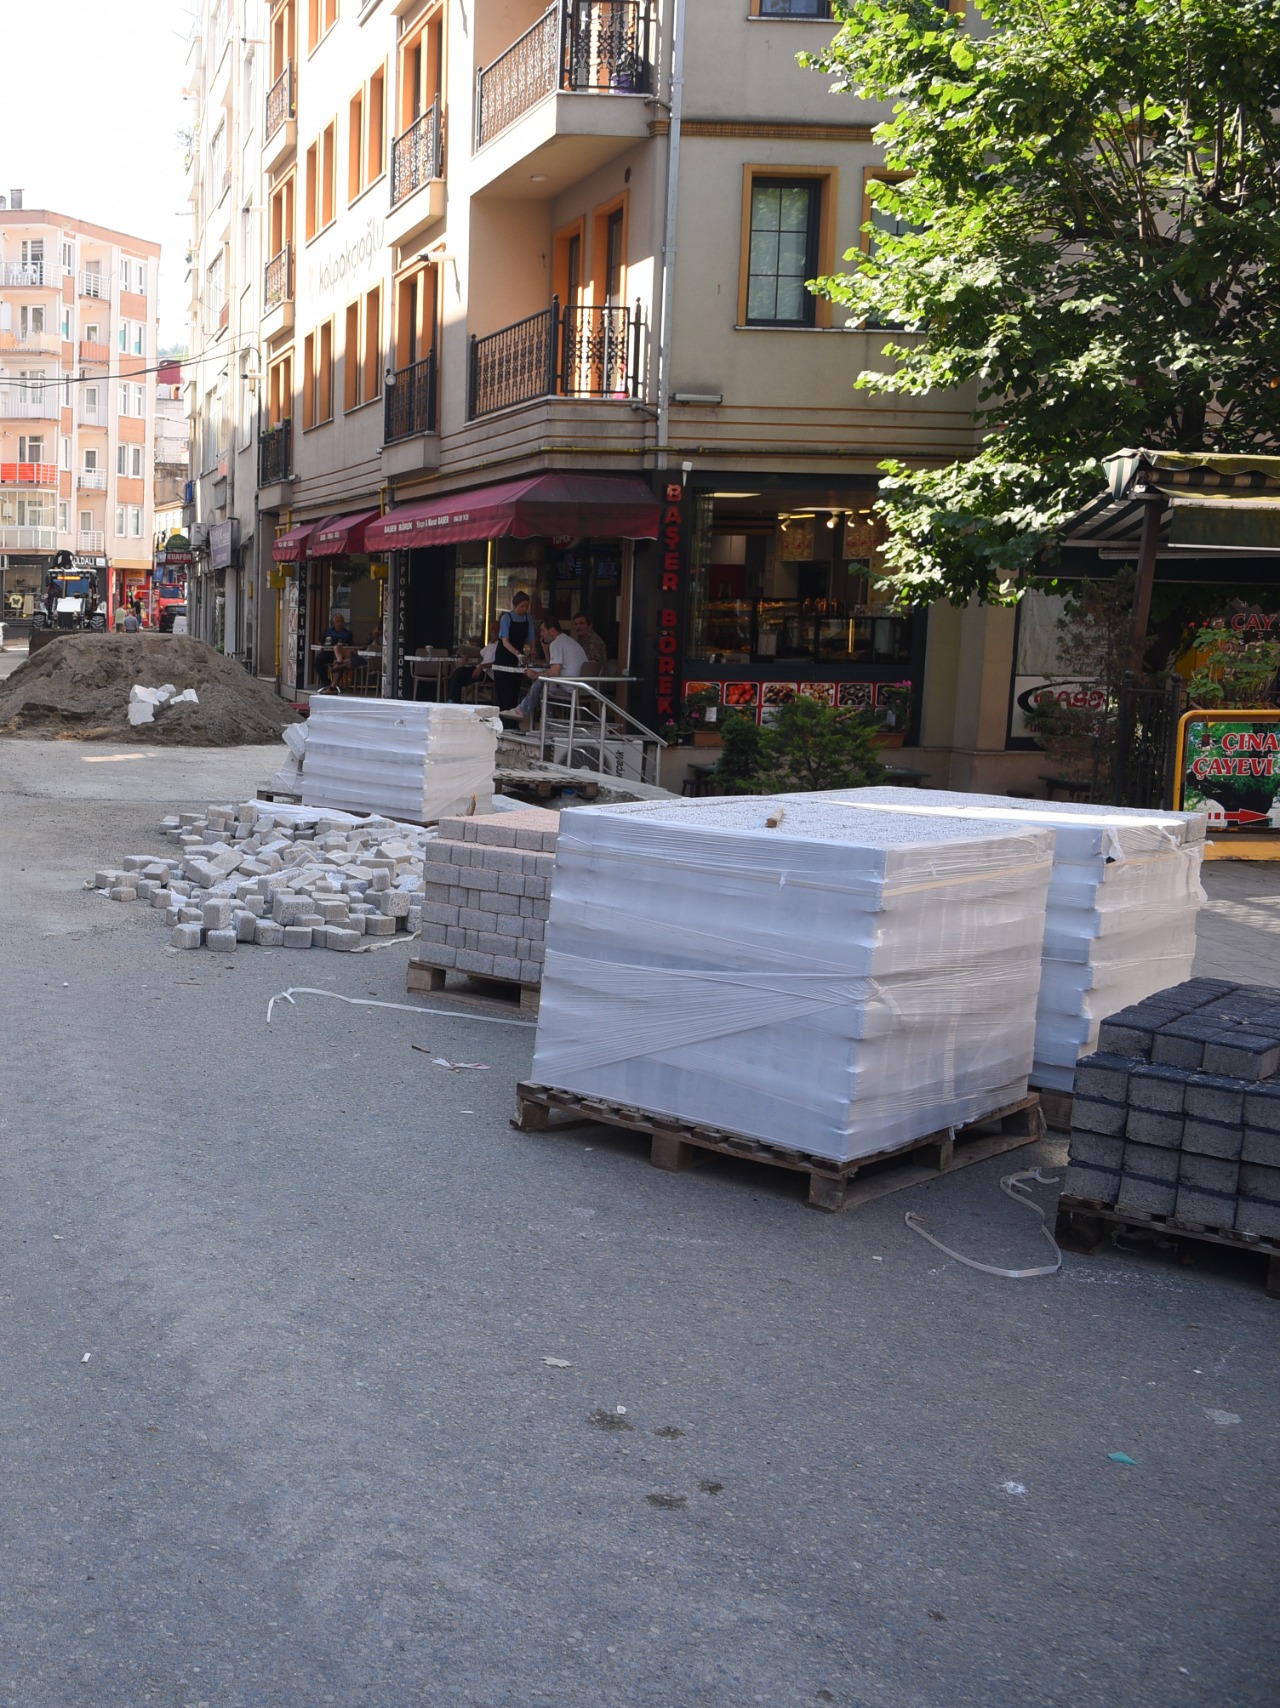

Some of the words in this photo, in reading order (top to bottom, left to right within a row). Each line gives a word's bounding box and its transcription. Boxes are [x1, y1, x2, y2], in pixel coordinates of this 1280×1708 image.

[662, 483, 682, 591] BAŞER
[657, 609, 678, 714] BÖREK
[1192, 753, 1275, 781] ÇAYEVİ
